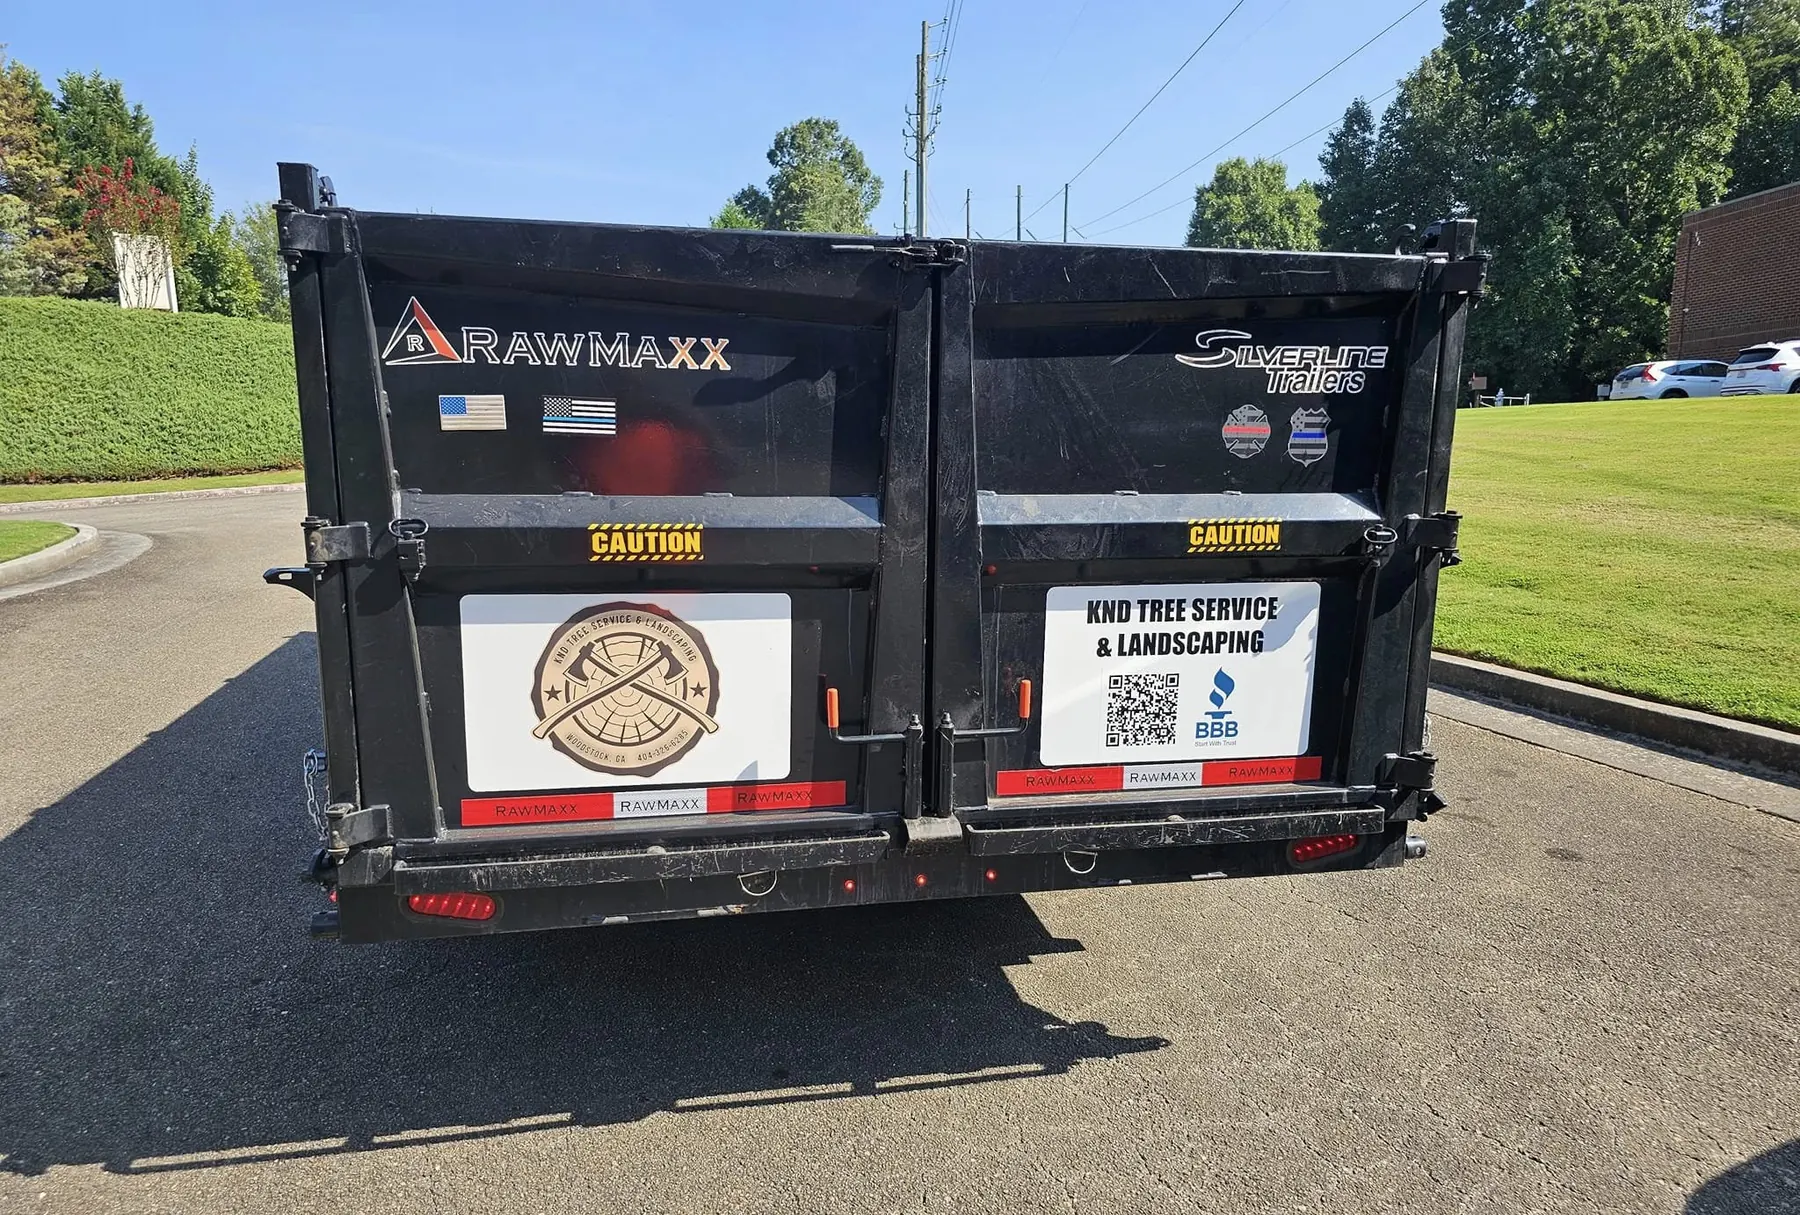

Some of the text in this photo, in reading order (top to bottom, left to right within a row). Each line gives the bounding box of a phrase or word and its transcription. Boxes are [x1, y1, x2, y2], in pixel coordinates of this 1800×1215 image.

[1266, 364, 1365, 393] Trailers
[591, 531, 701, 553] CAUTION
[1189, 524, 1280, 546] CAUTION
[1086, 597, 1279, 624] KND TREE SERVICE
[553, 614, 697, 664] KND TREE SERVICE & LANDSCAPING
[1096, 630, 1265, 657] & LANDSCAPING
[1195, 721, 1239, 739] BBB
[615, 755, 626, 763] GA
